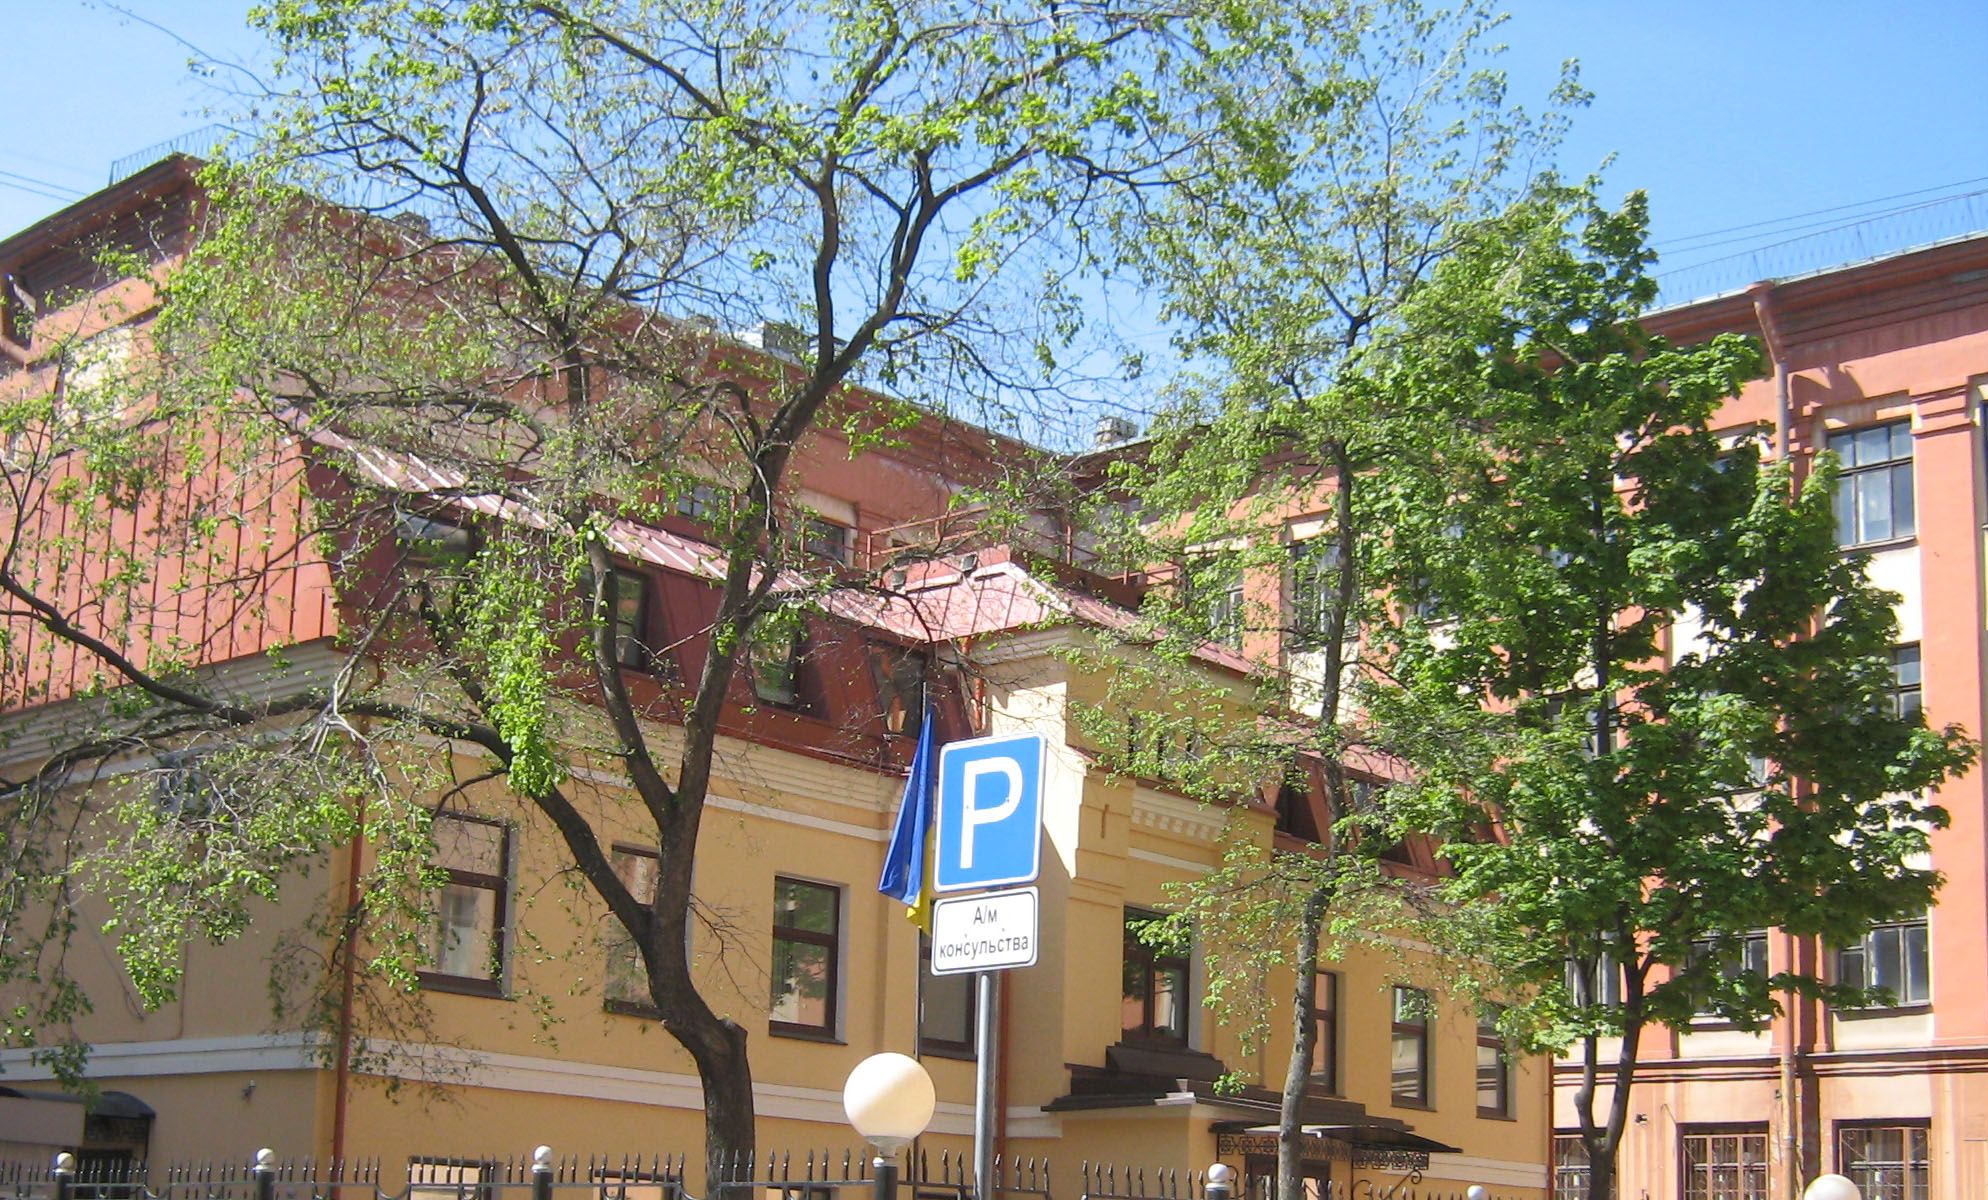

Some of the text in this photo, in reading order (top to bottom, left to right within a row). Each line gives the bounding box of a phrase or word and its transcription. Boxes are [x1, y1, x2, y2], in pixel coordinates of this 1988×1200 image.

[960, 756, 1023, 869] P
[973, 905, 998, 925] А/м
[939, 935, 1029, 960] консульства
